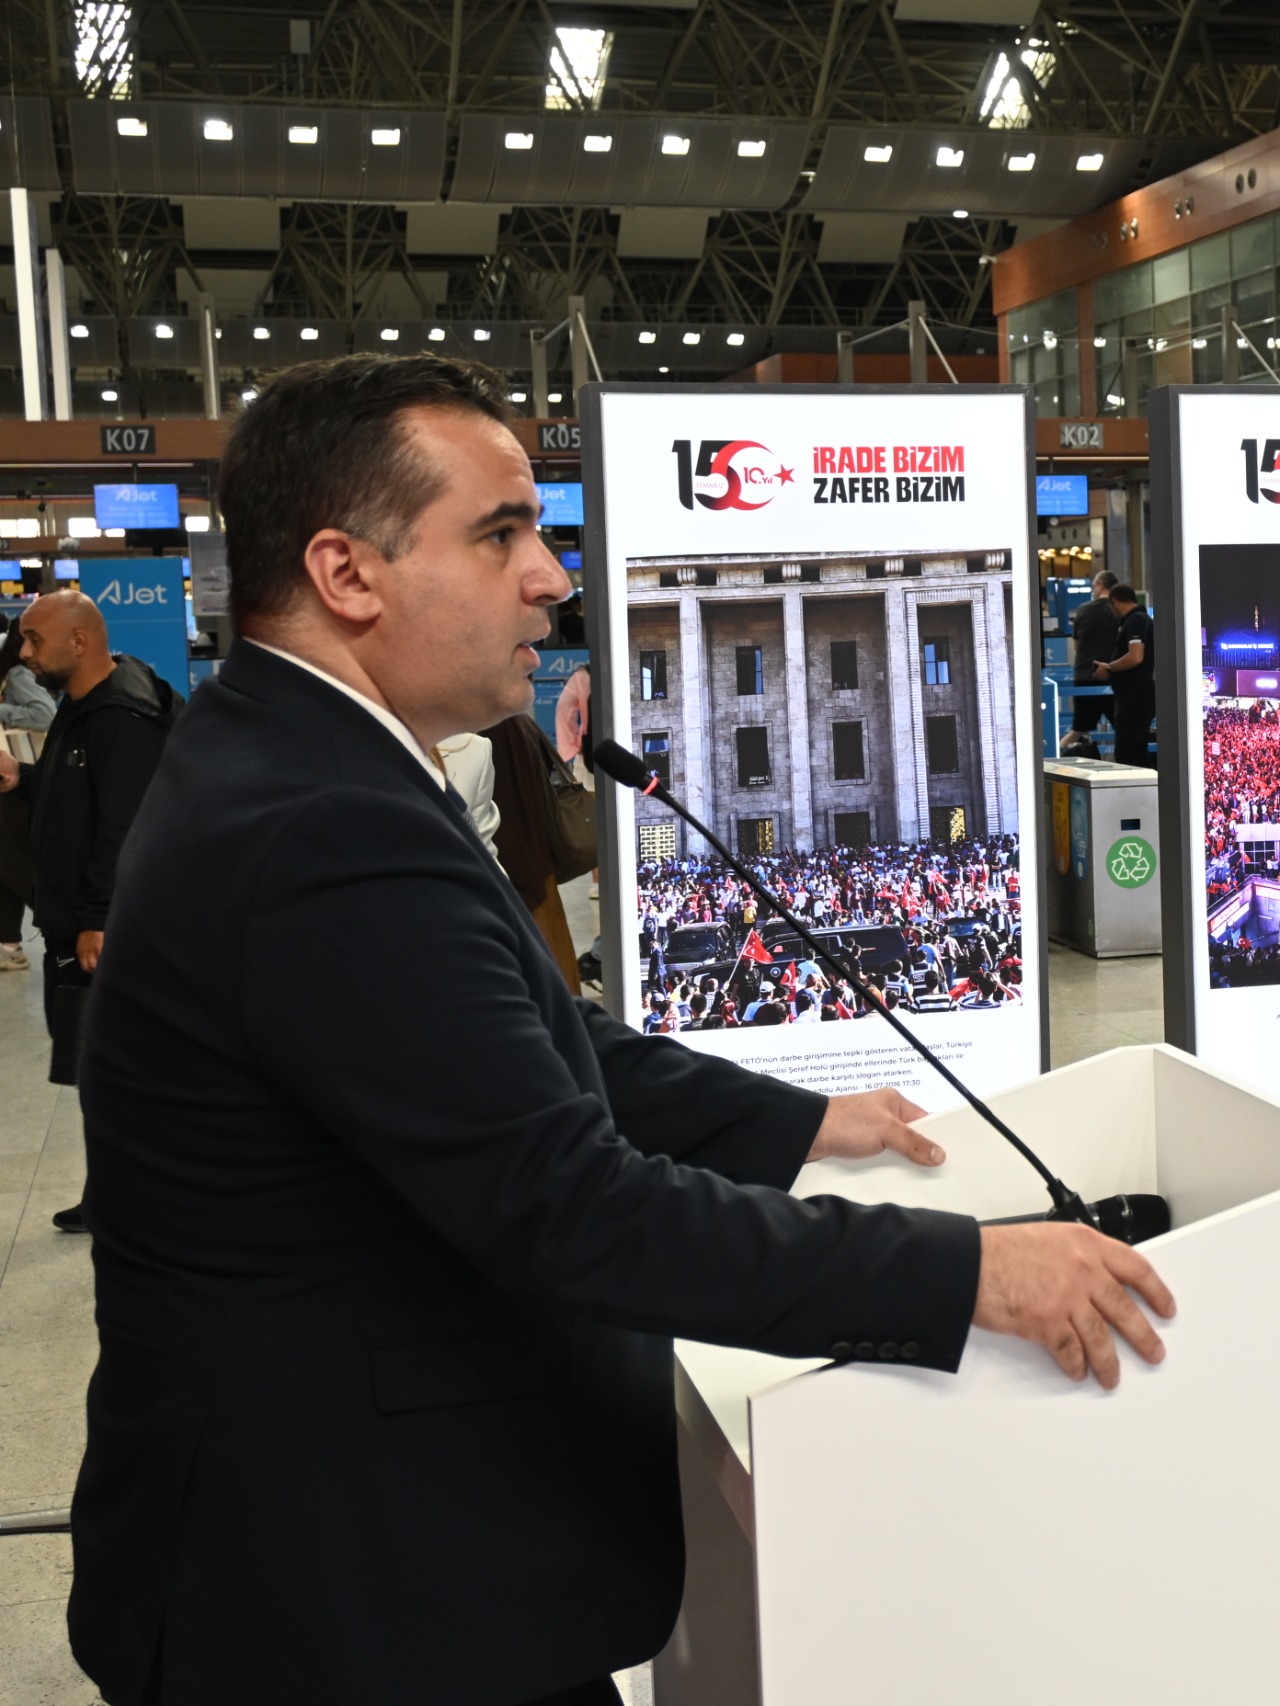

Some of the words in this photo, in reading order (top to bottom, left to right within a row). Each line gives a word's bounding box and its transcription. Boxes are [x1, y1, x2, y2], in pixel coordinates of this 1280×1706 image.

[106, 429, 149, 451] K07
[543, 427, 581, 449] K05
[1064, 425, 1099, 446] K02
[115, 488, 158, 502] AJet
[813, 477, 890, 504] ZAFER
[97, 579, 167, 605] AJet
[741, 1056, 778, 1065] FETÖ'nün
[780, 1054, 802, 1062] darbe
[804, 1052, 842, 1061] girişimine
[844, 1049, 863, 1057] tepki
[865, 1048, 898, 1056] gösteren
[900, 1042, 944, 1054] vataaşlar,
[946, 1040, 973, 1048] Türkiye
[760, 1067, 787, 1075] Meclisi
[789, 1065, 808, 1073] Şeref
[810, 1063, 828, 1071] Holü
[830, 1061, 862, 1071] girişinde
[864, 1058, 896, 1066] ellerinde
[899, 1056, 915, 1064] Türk
[956, 1052, 964, 1060] ile
[807, 1075, 829, 1083] darbe
[831, 1073, 854, 1081] karşıtı
[856, 1071, 881, 1079] slogan
[883, 1069, 913, 1077] atarken.
[836, 1086, 858, 1095] Ajansı
